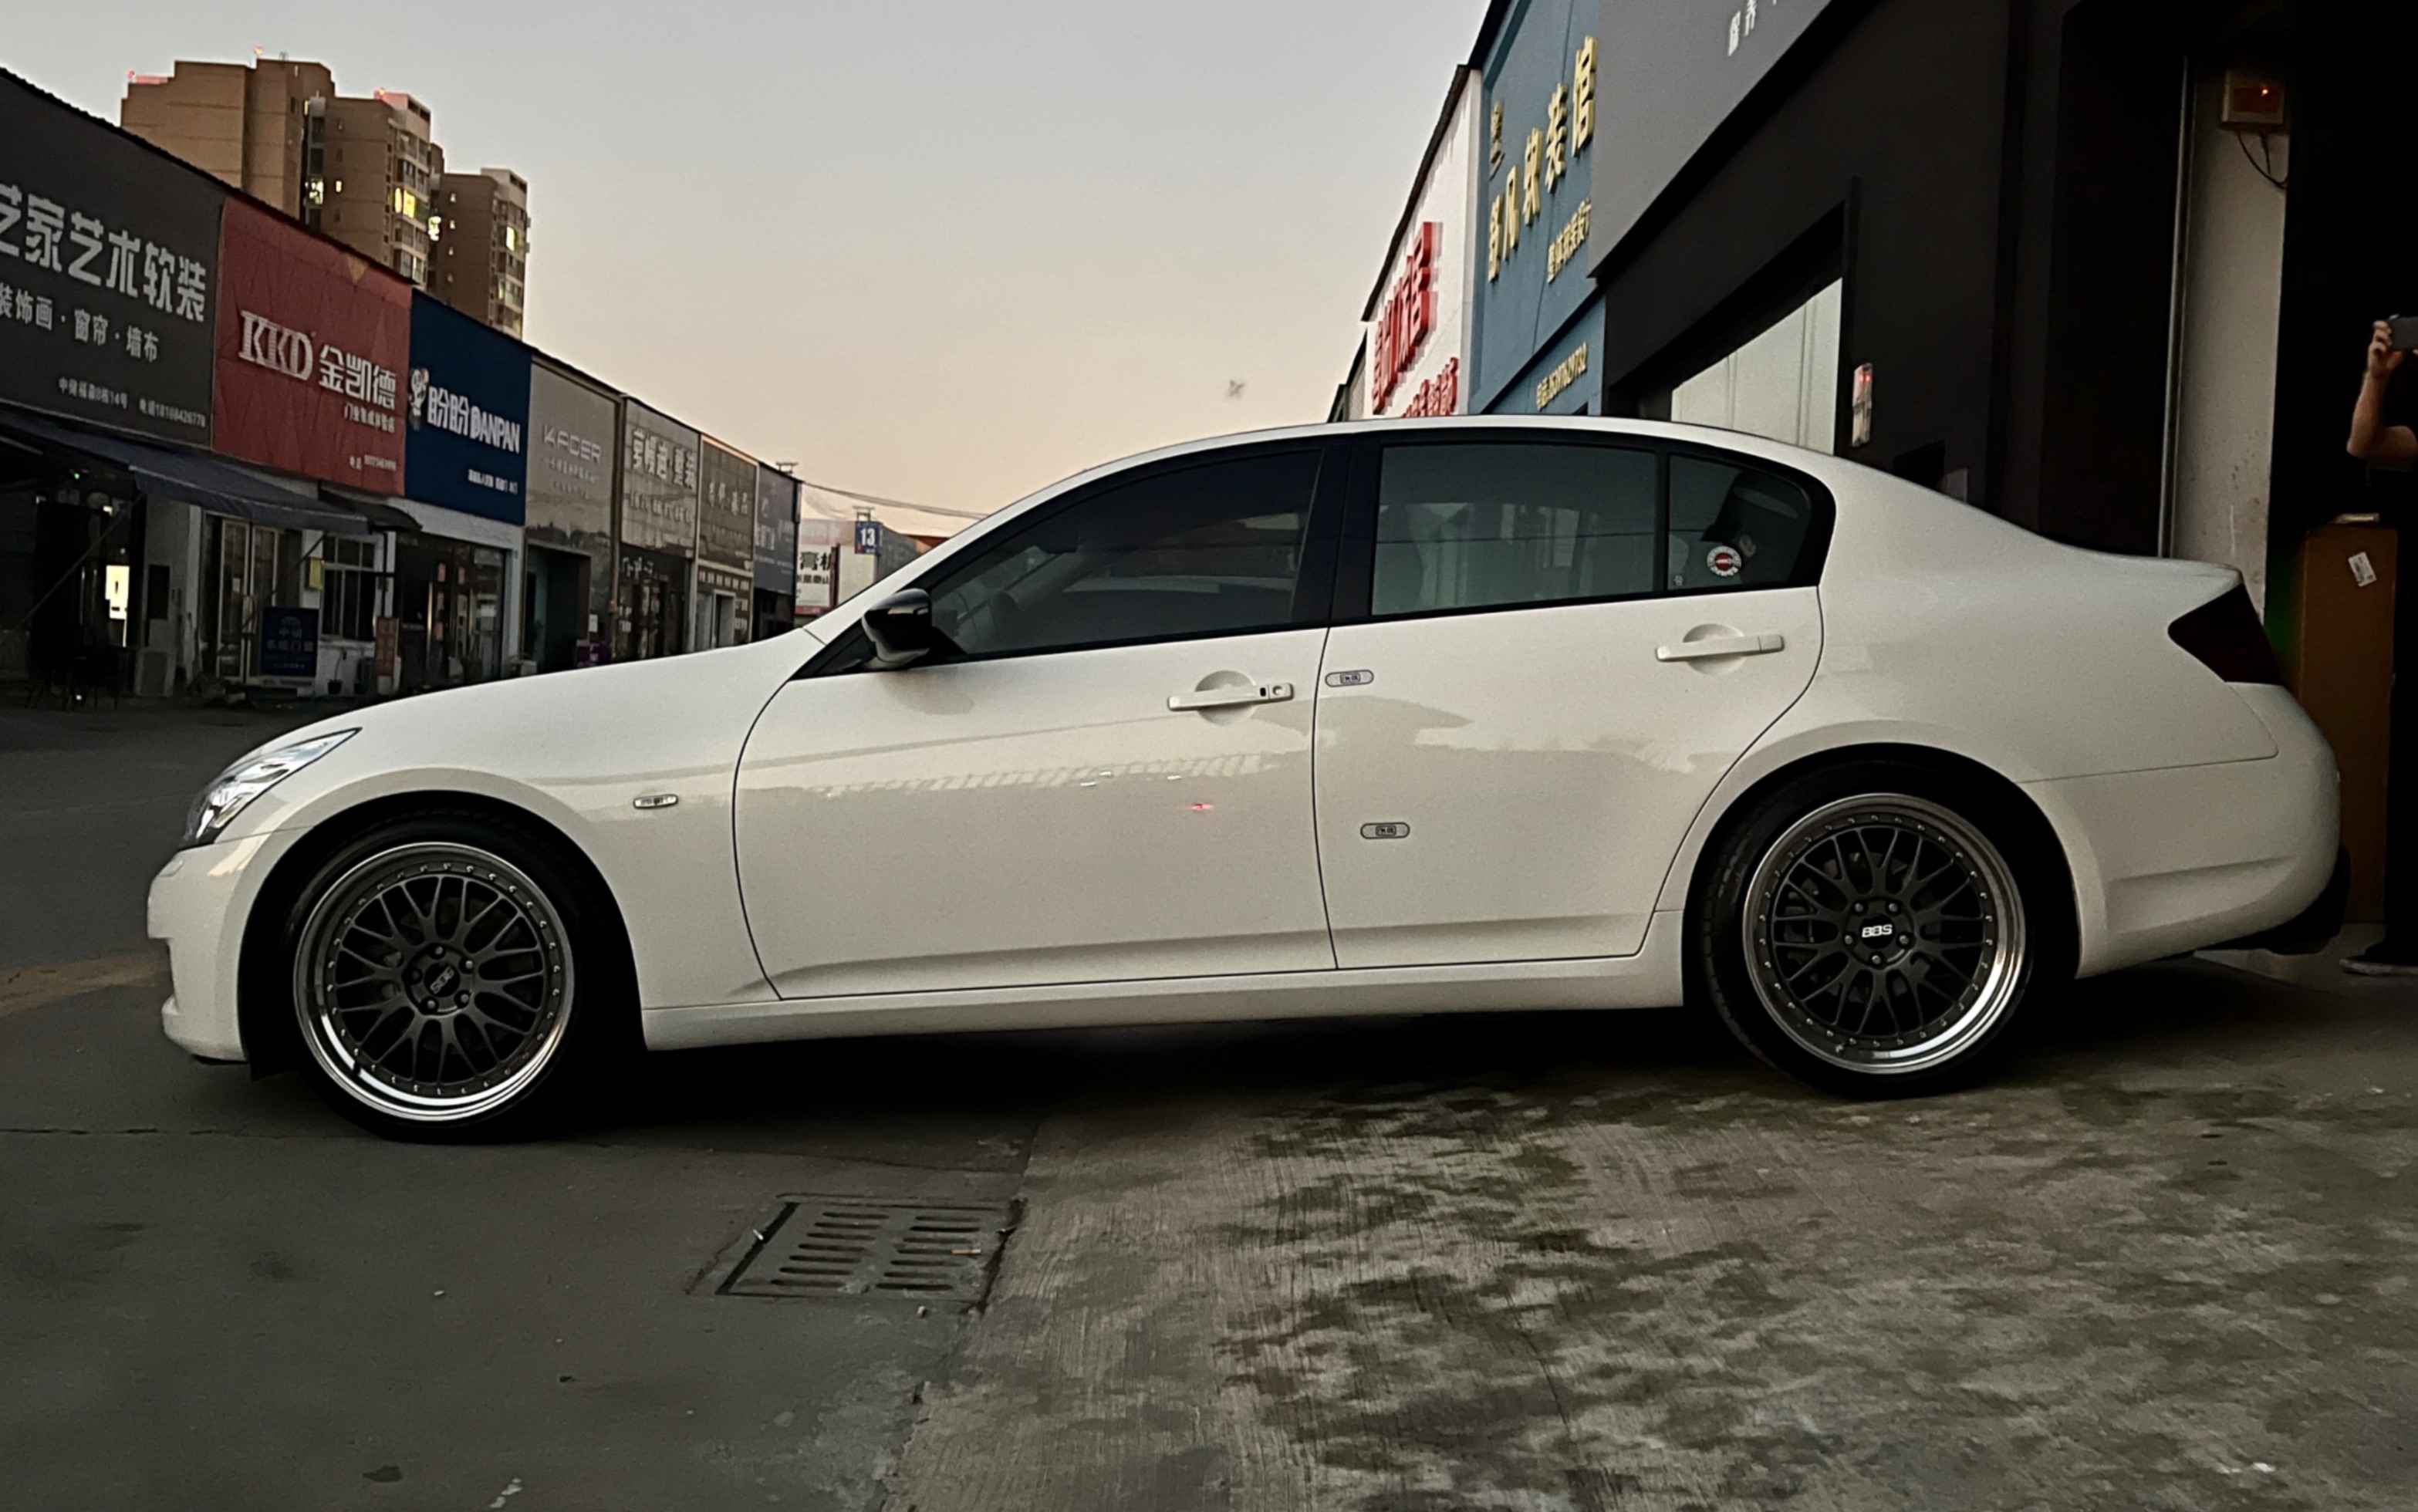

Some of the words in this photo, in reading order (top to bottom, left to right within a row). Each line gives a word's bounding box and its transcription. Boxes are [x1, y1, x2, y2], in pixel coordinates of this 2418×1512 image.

[238, 310, 314, 381] KKD
[319, 344, 397, 410] 金凯德
[1862, 923, 1893, 938] BBS
